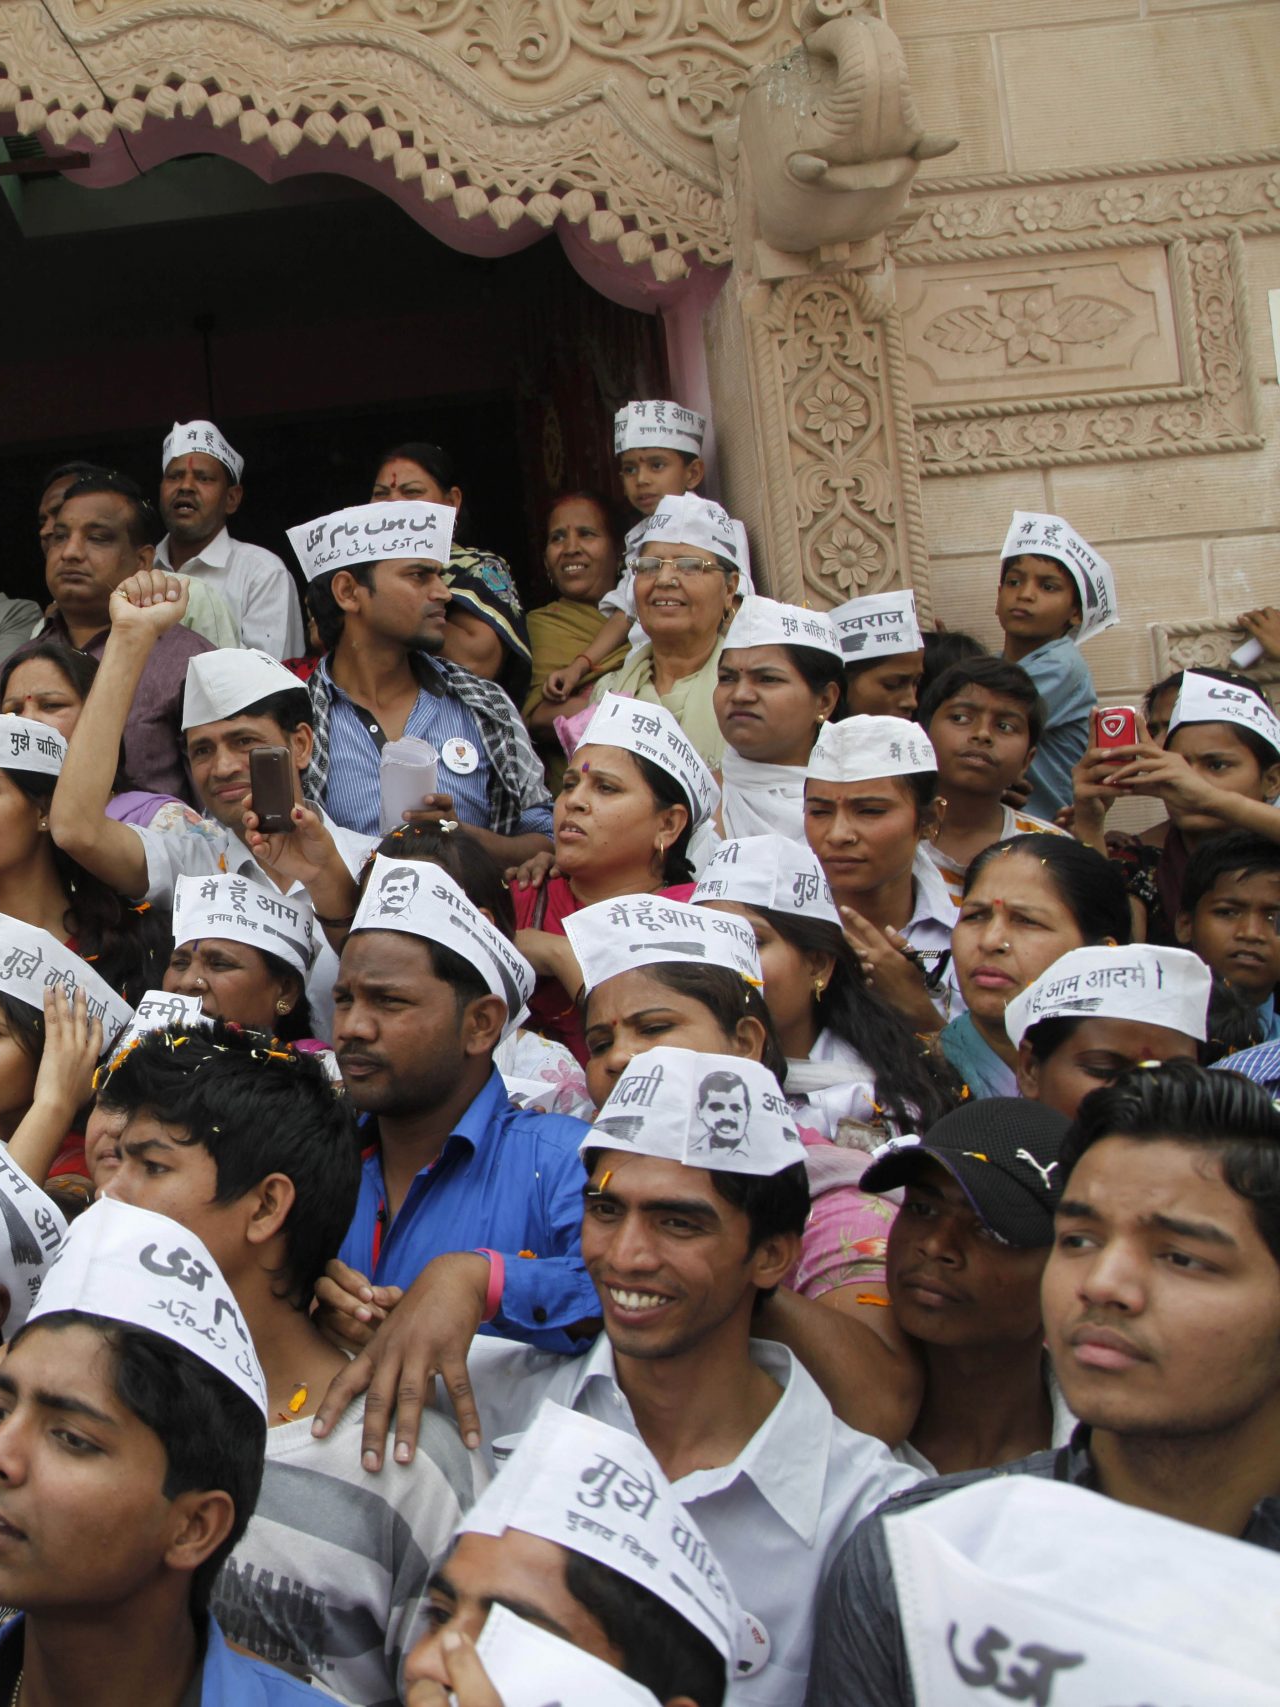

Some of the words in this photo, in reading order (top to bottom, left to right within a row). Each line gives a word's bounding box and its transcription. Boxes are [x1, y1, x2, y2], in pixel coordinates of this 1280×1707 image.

[653, 401, 665, 424] हूँ
[672, 407, 695, 425] आम
[330, 522, 359, 548] عام
[1020, 521, 1037, 534] मैं
[1067, 538, 1097, 570] आम
[780, 613, 799, 636] मुझे
[837, 610, 904, 633] स्वराज
[10, 729, 30, 756] मुझे
[36, 736, 63, 762] चाहिए
[632, 713, 662, 737] मुझे
[667, 731, 700, 778] चाहिए
[200, 879, 219, 901] मैं
[228, 880, 248, 913] हूँ
[256, 894, 299, 928] आम
[793, 865, 820, 908] मुझे
[207, 912, 233, 925] चुनाव
[236, 913, 258, 931] चिन्ह
[606, 902, 631, 929] मैं
[635, 900, 665, 932] हूँ
[658, 907, 706, 933] आम
[431, 884, 477, 924] आम
[482, 925, 526, 987] आदमी
[0, 946, 45, 981] मुझे
[1046, 974, 1081, 999] आम
[138, 997, 189, 1024] दमी
[139, 1242, 213, 1292] آدمی
[576, 1453, 662, 1521] मुझे
[565, 1509, 620, 1543] चुनाव
[621, 1534, 661, 1571] चिन्ह
